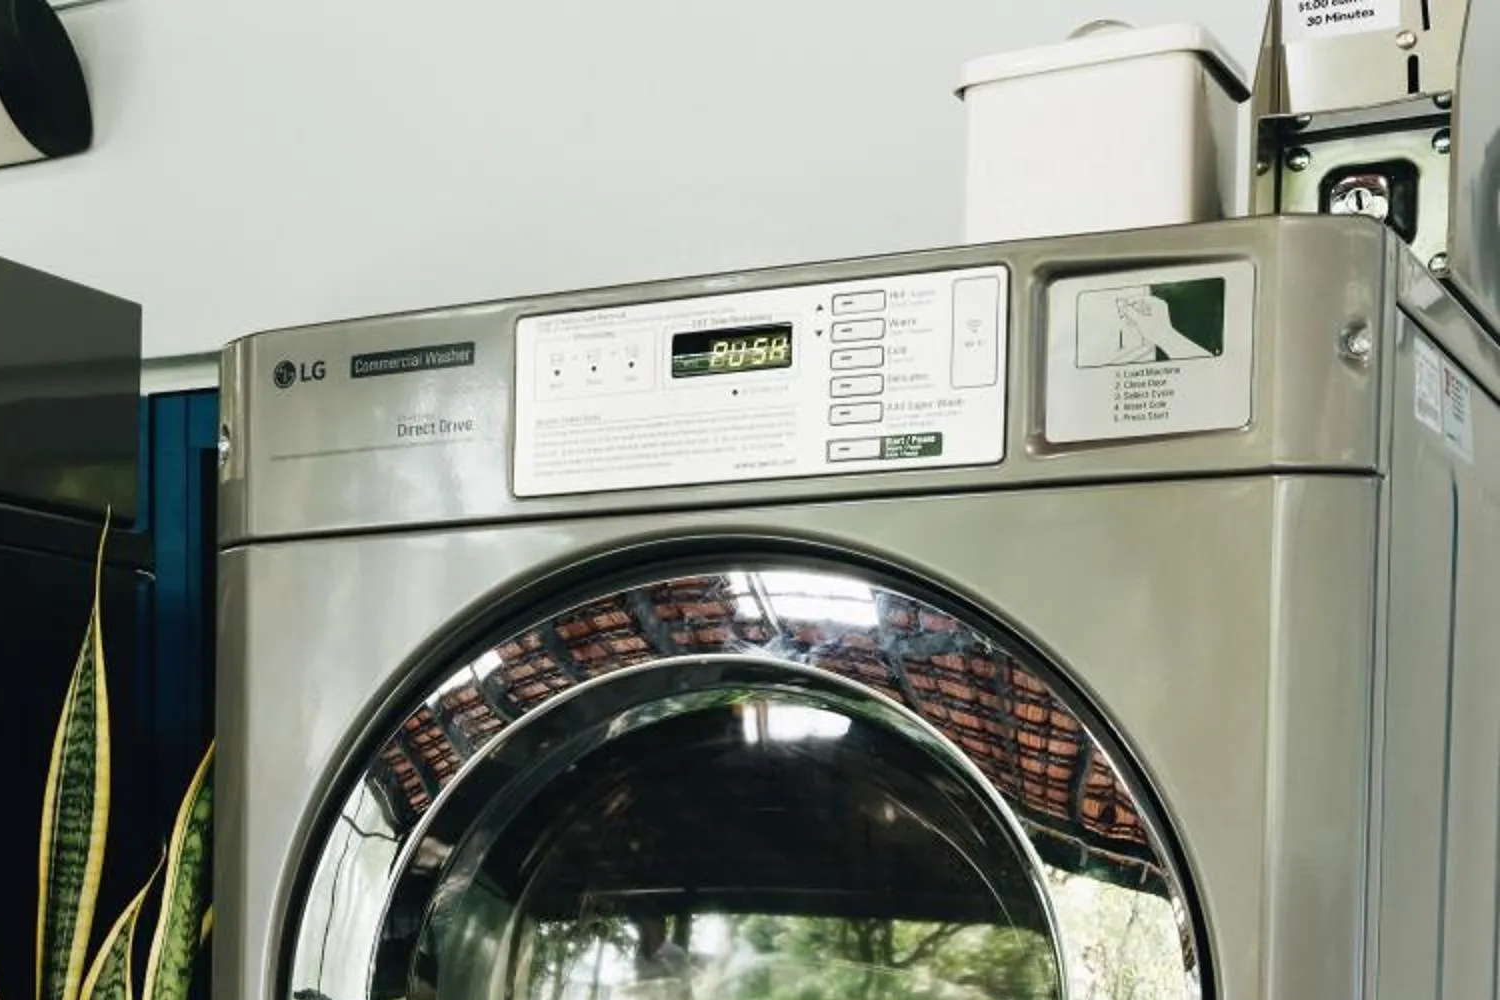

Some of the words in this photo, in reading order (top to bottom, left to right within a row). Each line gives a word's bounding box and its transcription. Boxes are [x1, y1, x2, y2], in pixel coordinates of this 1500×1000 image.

[1307, 15, 1323, 27] 30
[1325, 9, 1375, 23] Minutes
[355, 353, 421, 374] Commercial
[425, 347, 472, 366] Washer
[300, 361, 326, 382] LG
[396, 423, 435, 437] Direct
[439, 419, 474, 433] Drive
